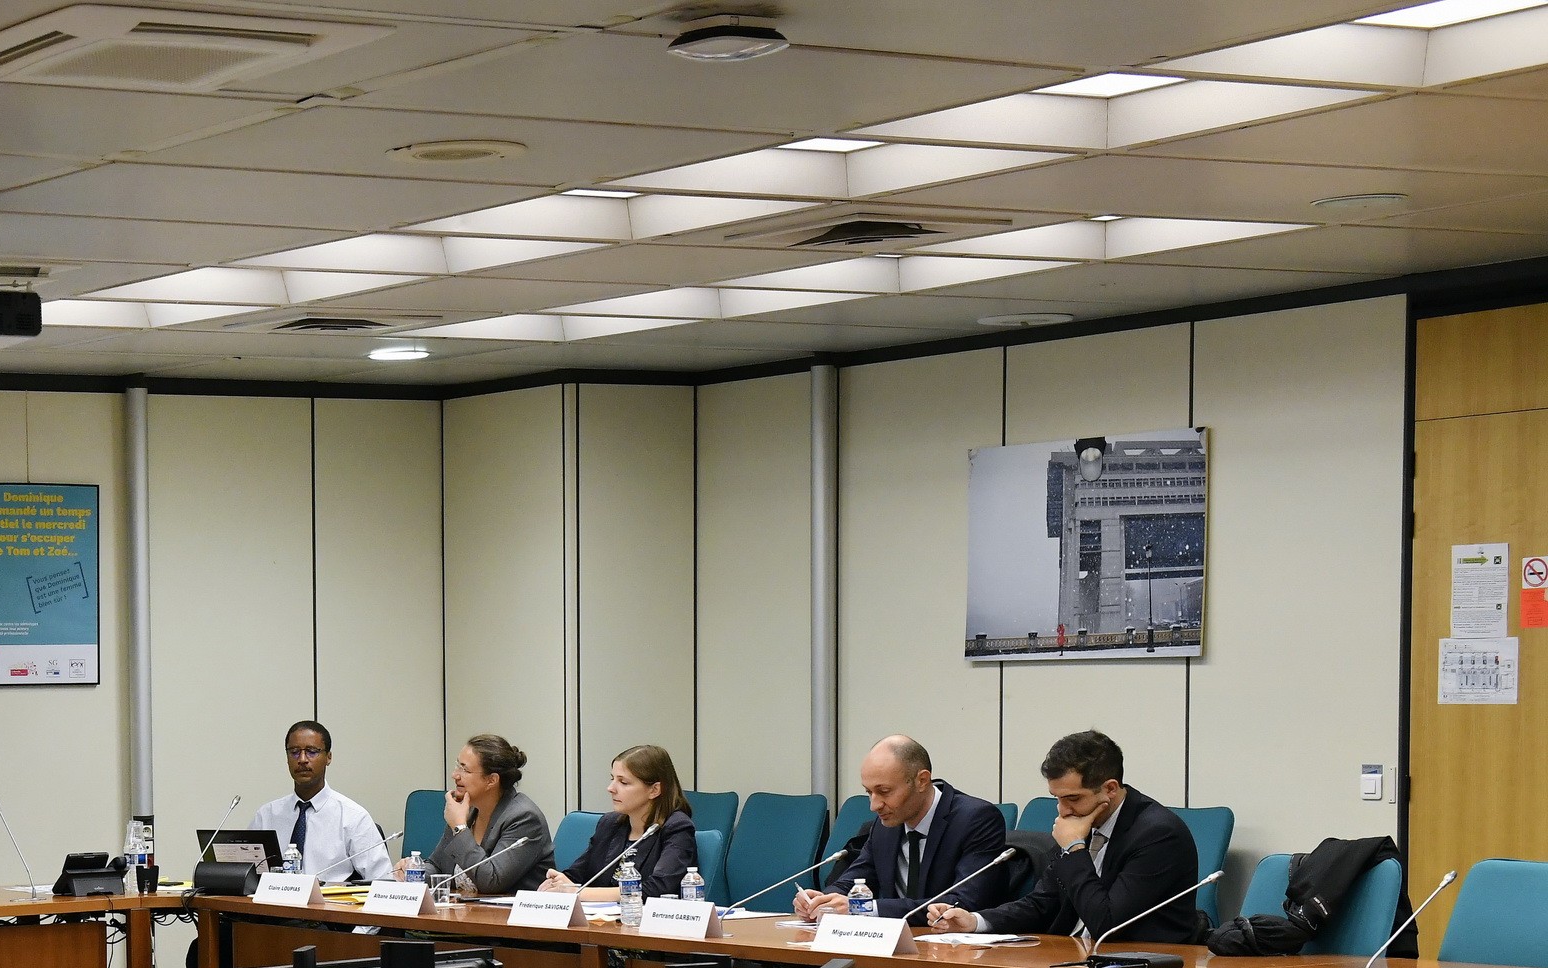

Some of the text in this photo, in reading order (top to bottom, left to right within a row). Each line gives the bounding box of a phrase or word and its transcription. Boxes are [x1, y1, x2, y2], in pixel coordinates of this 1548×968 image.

[4, 493, 63, 505] Dominique
[56, 507, 91, 518] temps
[35, 520, 86, 529] mercredi
[6, 546, 30, 556] Tom
[35, 575, 80, 593] que Dominique
[48, 589, 60, 597] une
[61, 582, 82, 592] femme
[38, 600, 52, 608] bien
[389, 894, 418, 902] SAUVEPLANE
[675, 914, 700, 922] GARBINTI
[832, 929, 853, 937] Miguel
